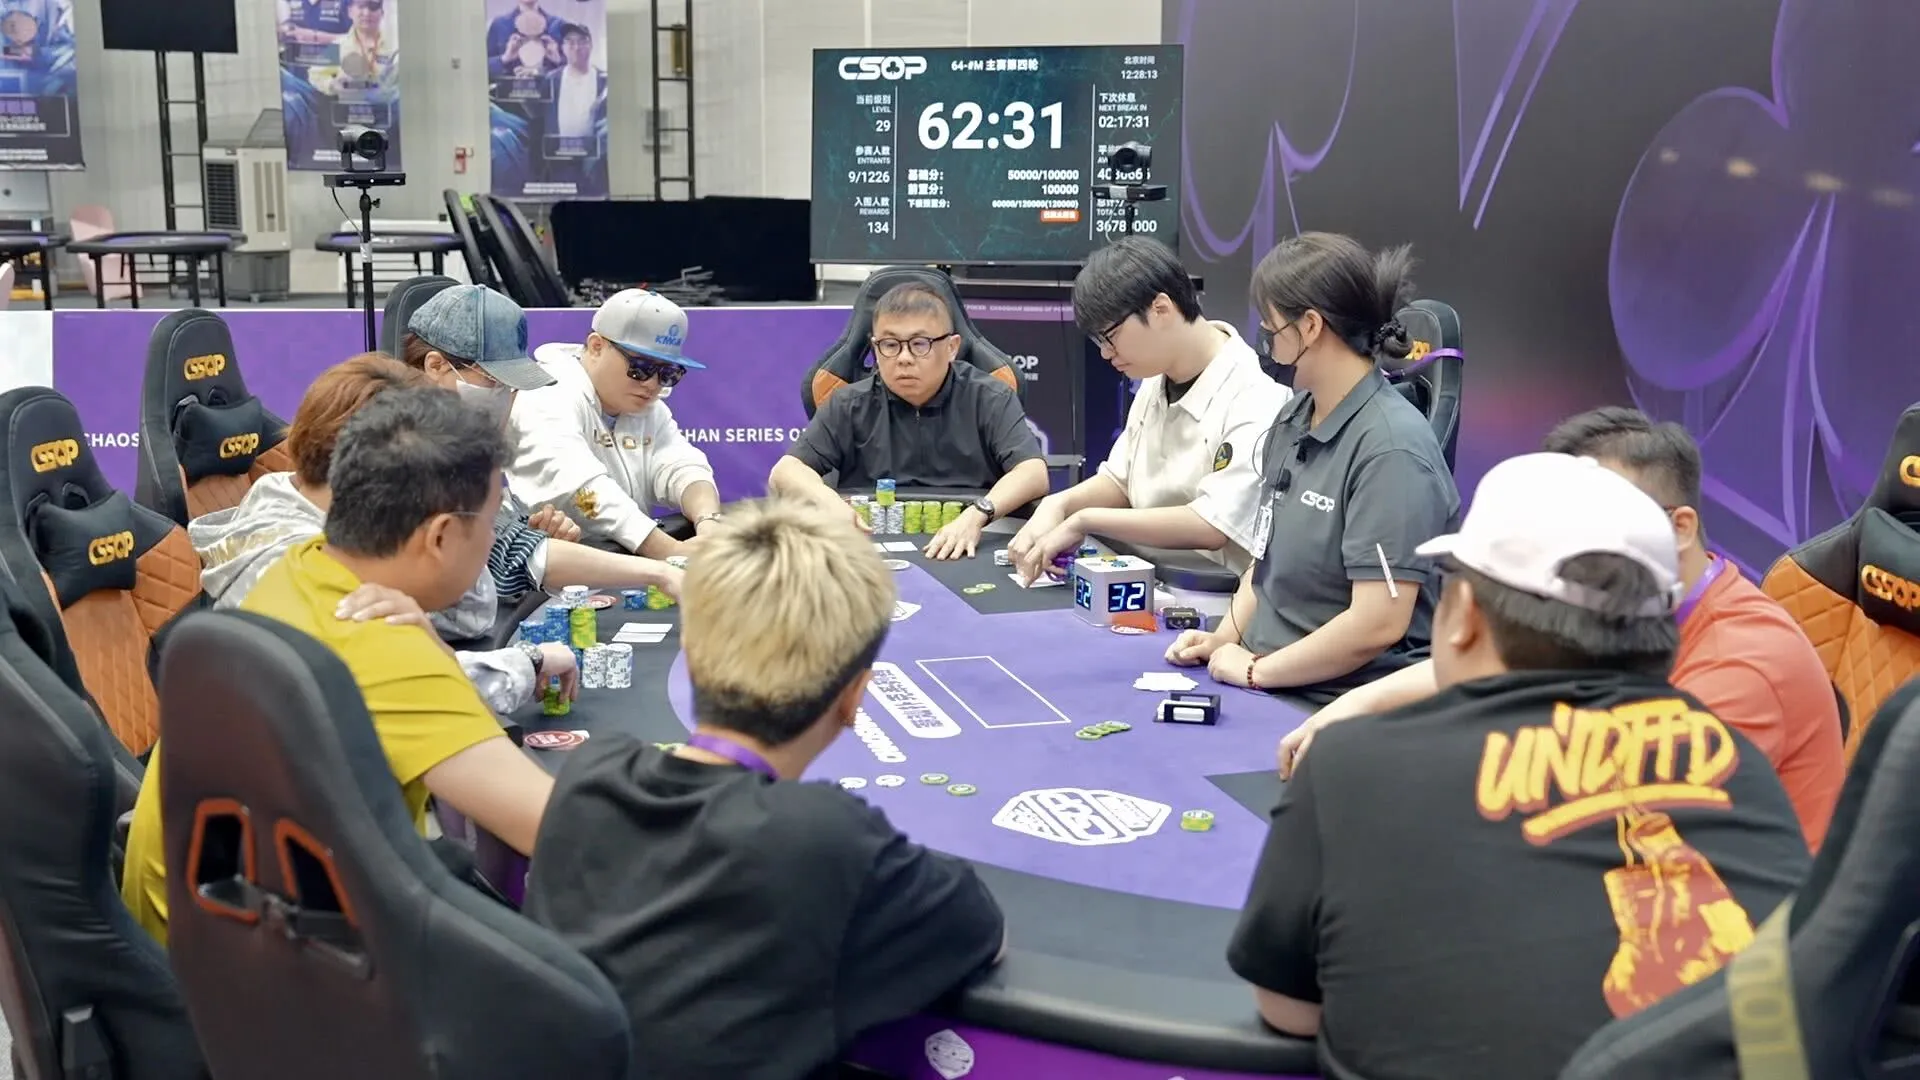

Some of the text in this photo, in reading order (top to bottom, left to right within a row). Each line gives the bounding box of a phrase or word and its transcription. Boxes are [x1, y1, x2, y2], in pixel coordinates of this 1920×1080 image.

[838, 56, 927, 80] CSOP
[1121, 69, 1158, 80] 12:28:13
[1099, 92, 1136, 103] 下次休息
[875, 120, 891, 132] 29
[917, 101, 1063, 151] 62:31
[1098, 115, 1150, 128] 02:17:31
[857, 157, 891, 165] ENTRANTS
[848, 171, 891, 184] 9/1226
[1007, 170, 1079, 181] 50000/100000
[1041, 184, 1079, 195] 100000
[859, 208, 890, 216] REWARDS
[867, 222, 890, 234] 134
[1096, 219, 1157, 233] 3678000
[725, 428, 784, 442] SERIES
[788, 428, 807, 441] O
[1110, 583, 1145, 611] 32
